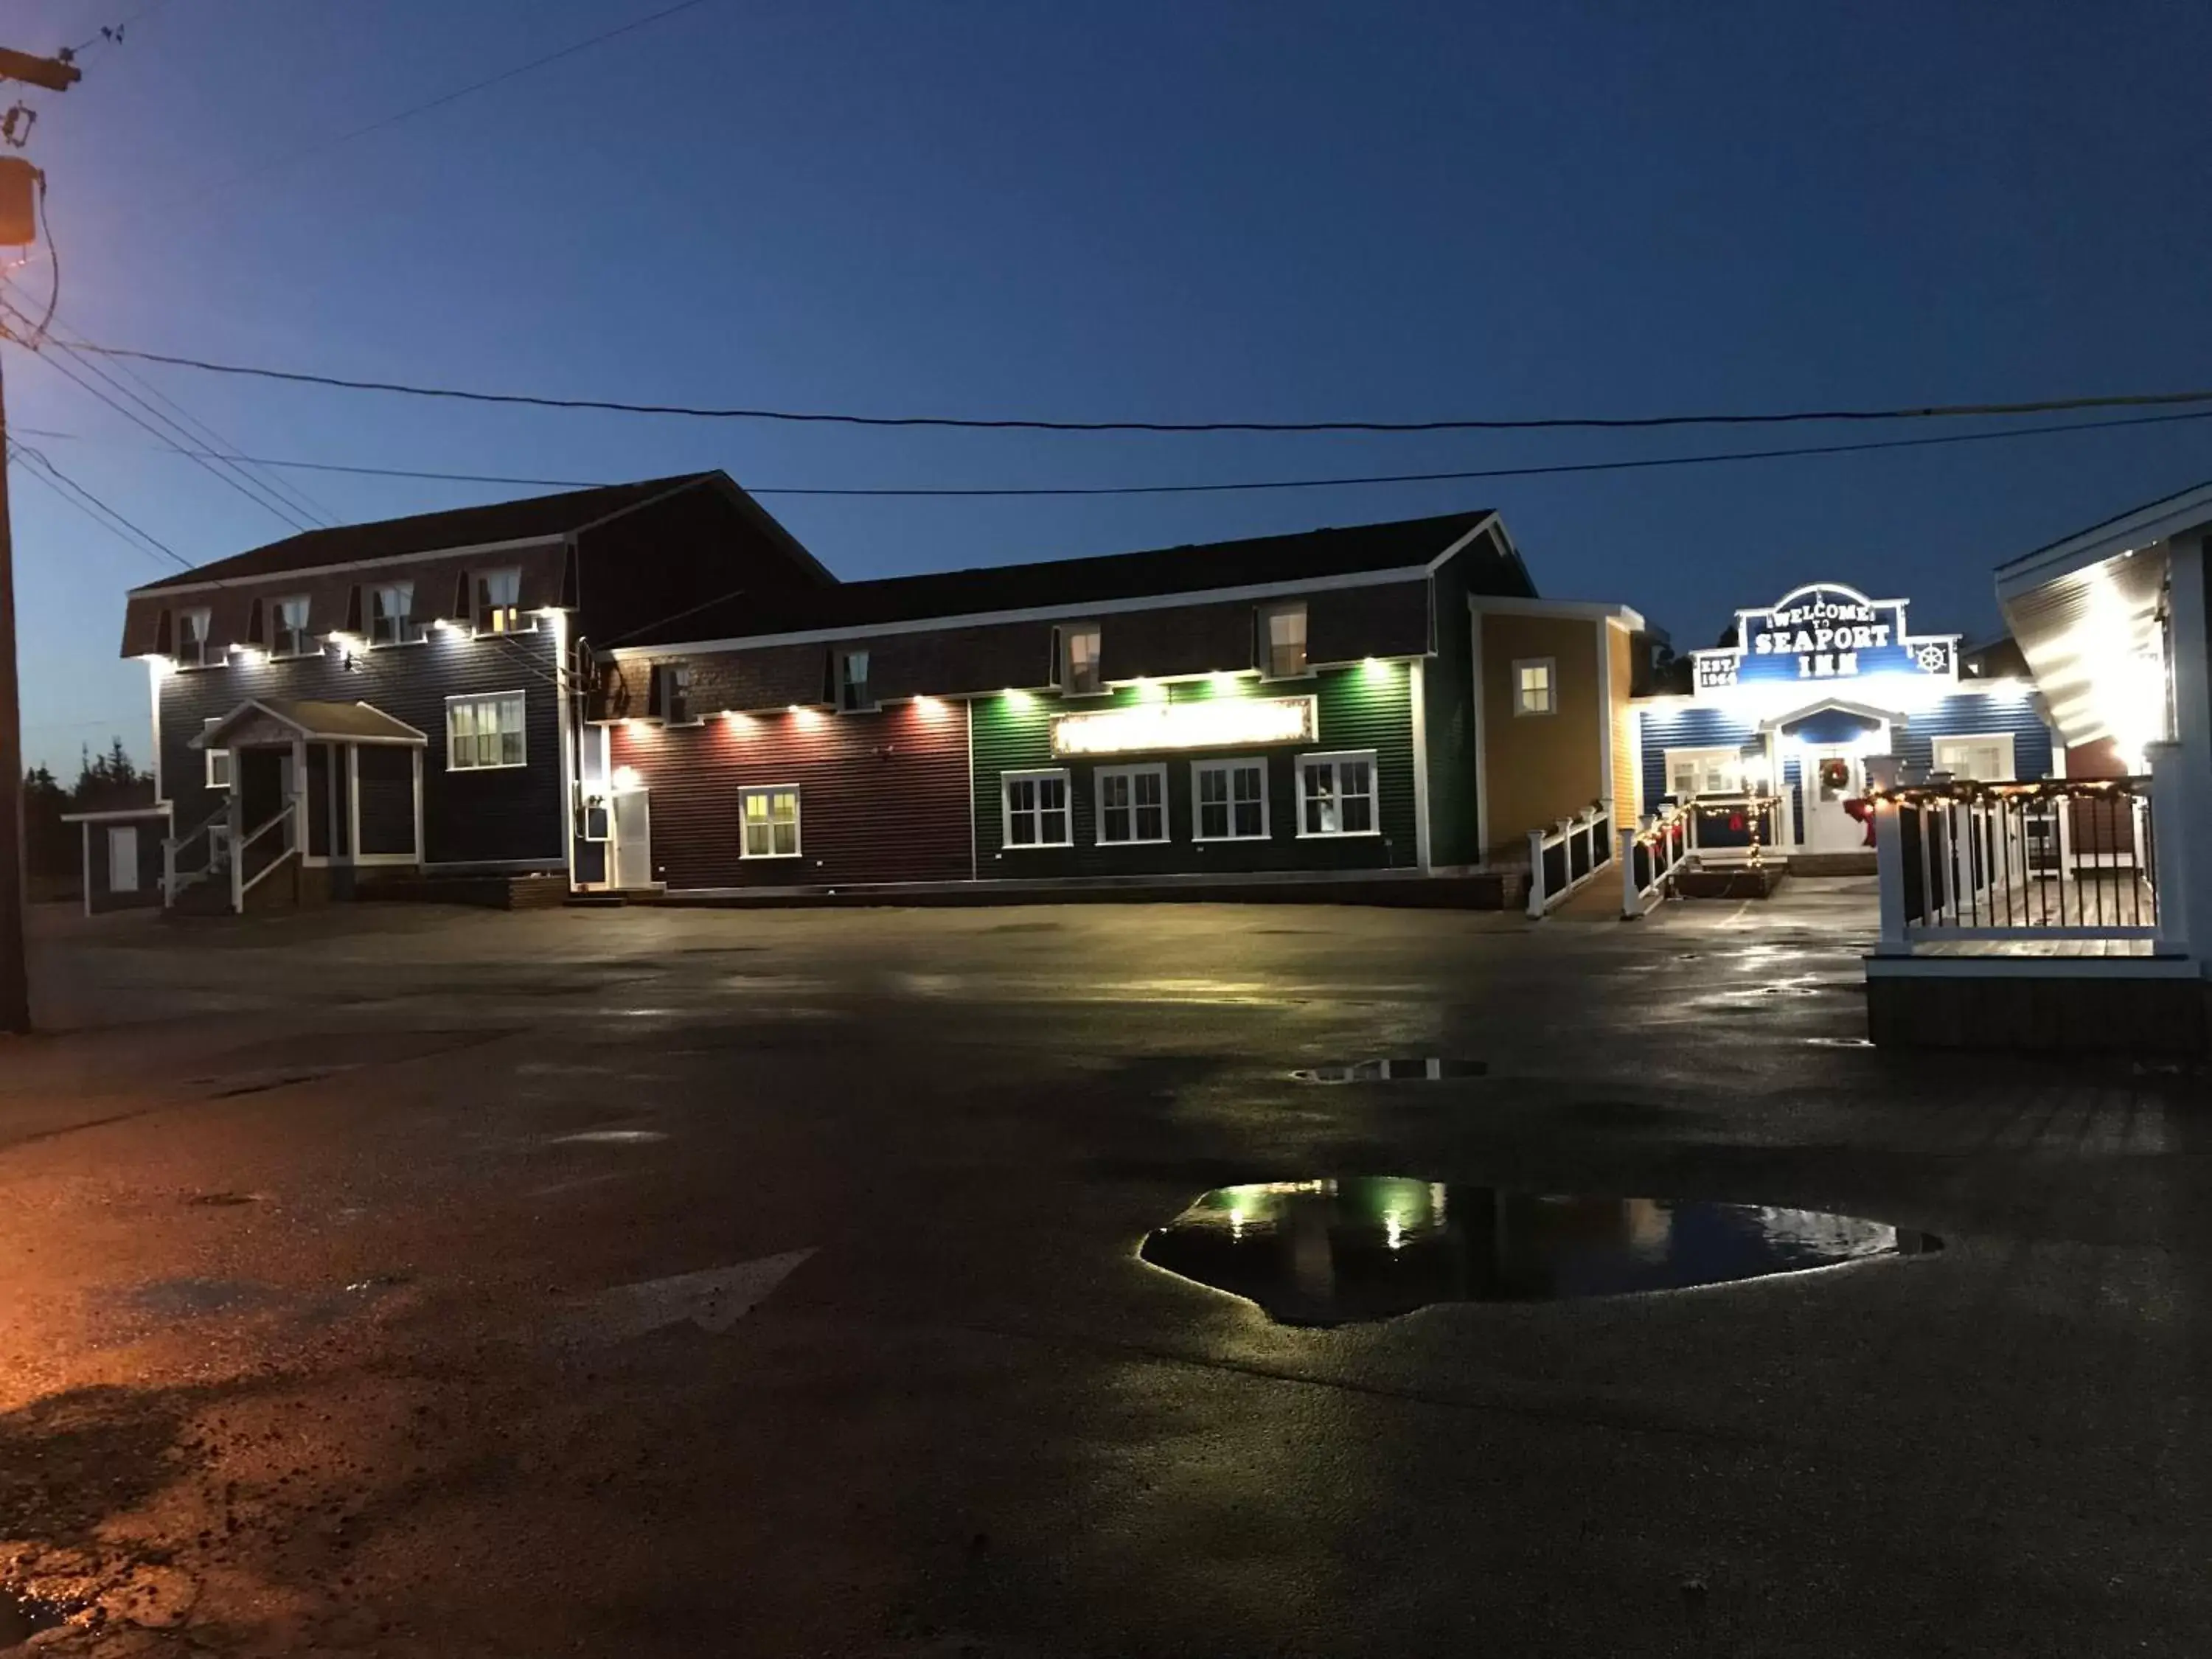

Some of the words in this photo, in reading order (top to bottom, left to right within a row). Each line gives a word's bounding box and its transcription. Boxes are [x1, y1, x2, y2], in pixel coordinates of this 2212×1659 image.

[1773, 604, 1868, 627] WELCOME
[1812, 619, 1829, 628] TO
[1756, 625, 1889, 654] SEAPORT
[1799, 653, 1857, 678] INN
